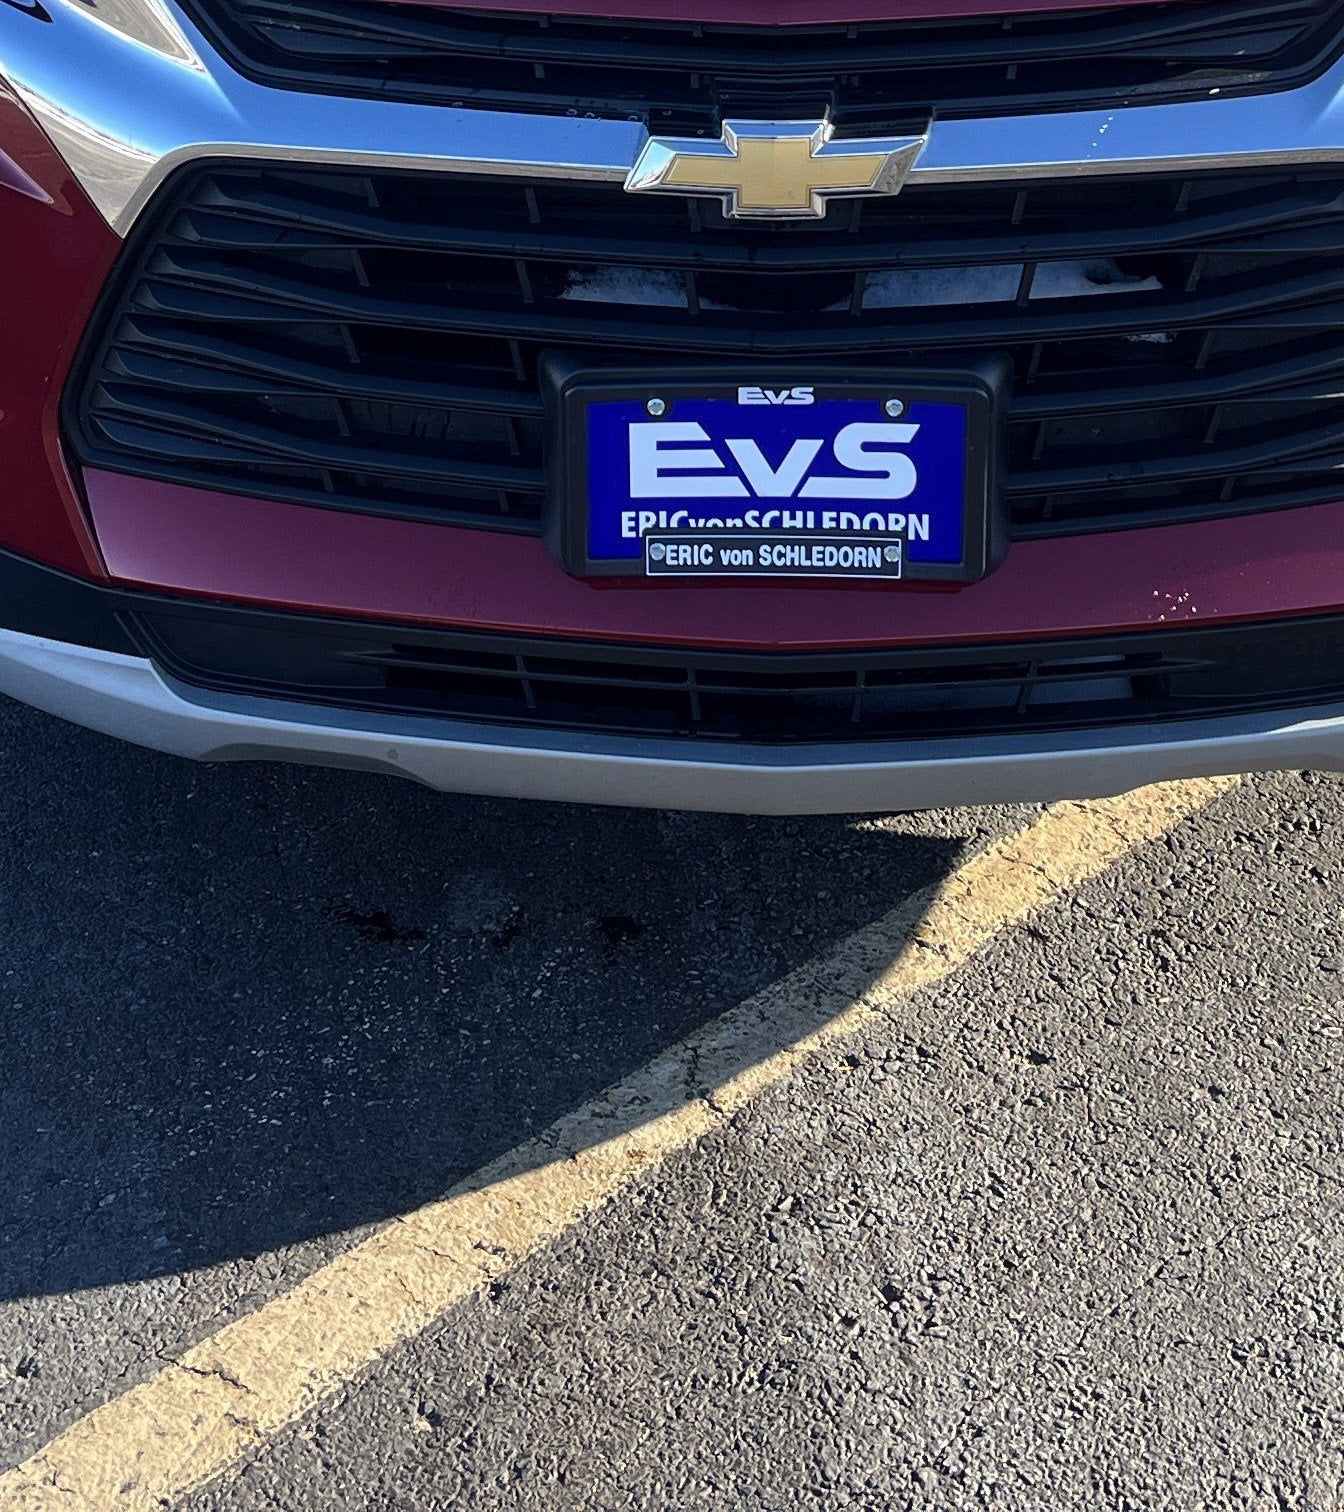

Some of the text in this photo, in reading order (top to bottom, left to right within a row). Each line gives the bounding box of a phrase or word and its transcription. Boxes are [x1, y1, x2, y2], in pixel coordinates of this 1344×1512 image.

[737, 386, 815, 405] EvS
[629, 422, 921, 500] EvS
[665, 544, 882, 568] ERIC von SCHLEDORN
